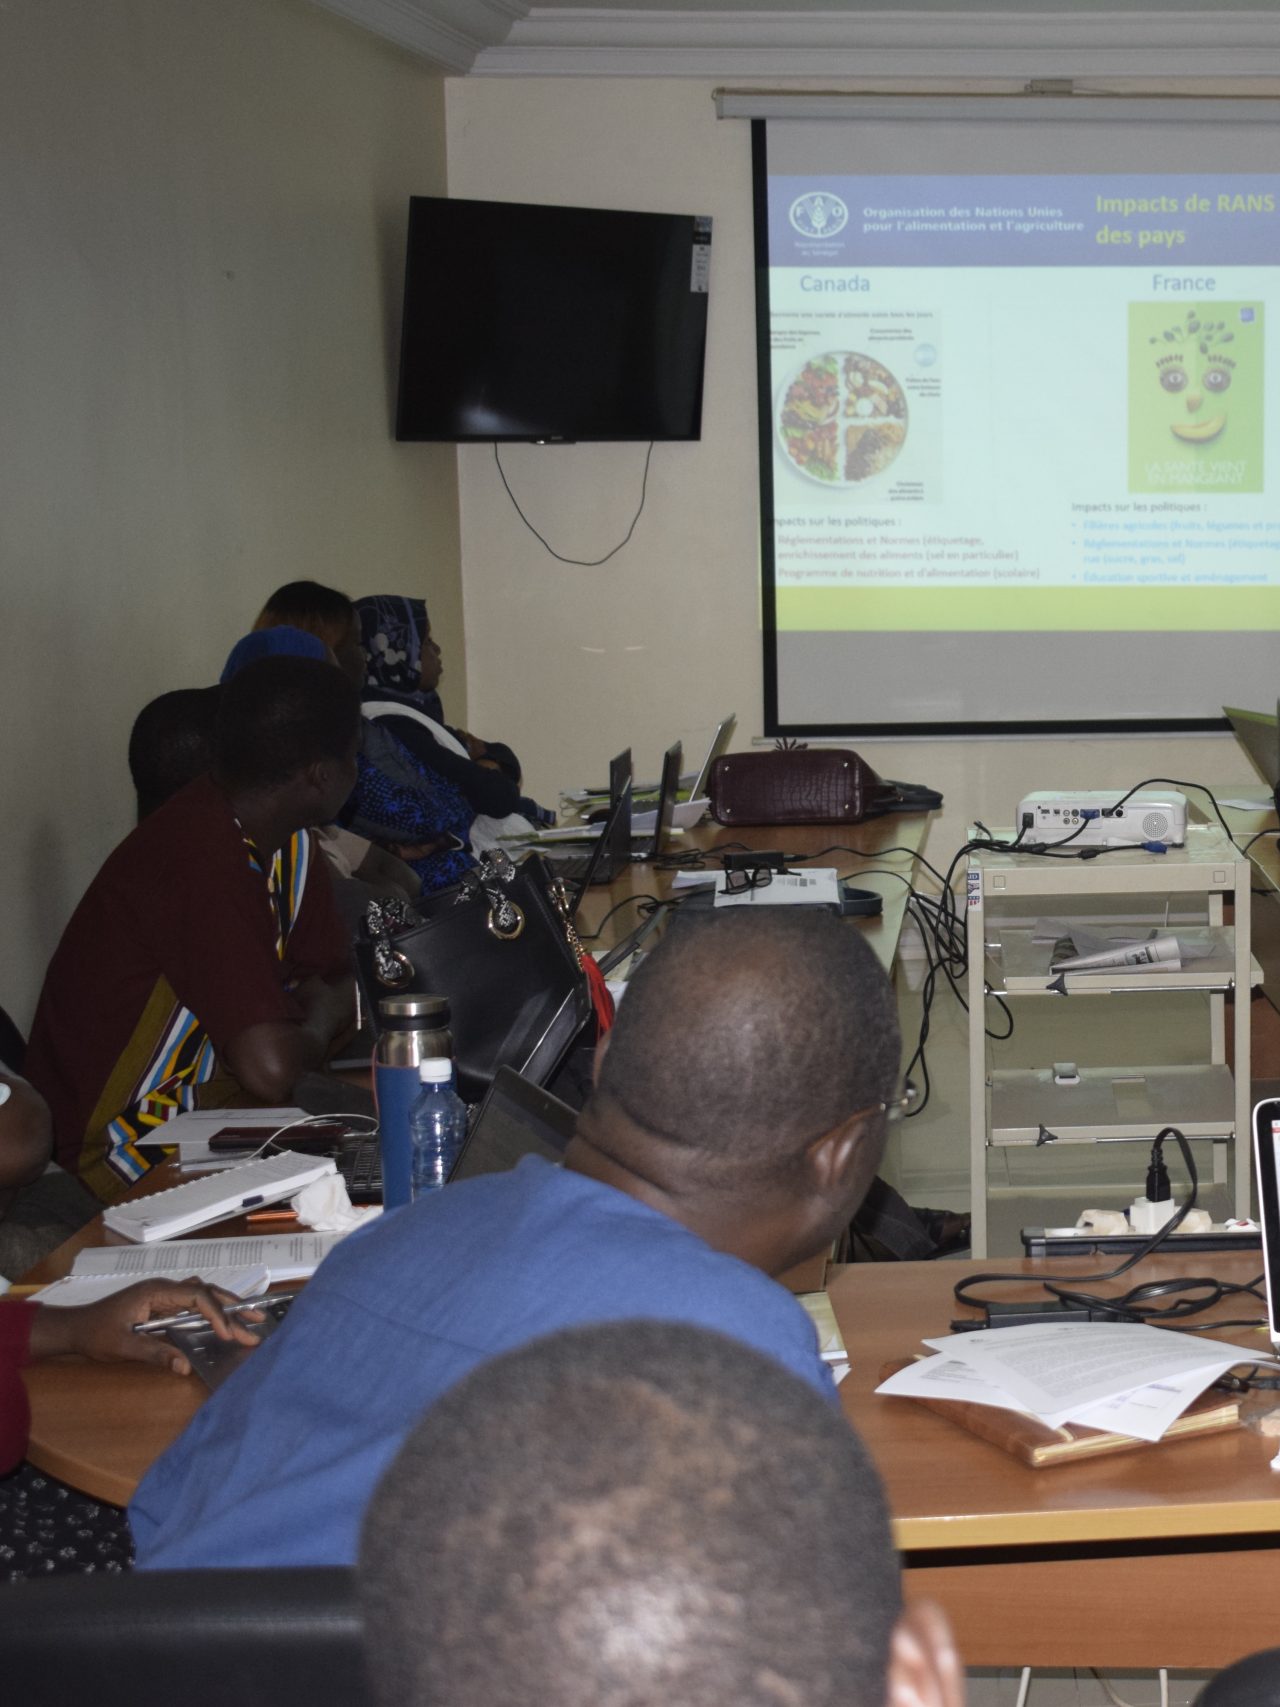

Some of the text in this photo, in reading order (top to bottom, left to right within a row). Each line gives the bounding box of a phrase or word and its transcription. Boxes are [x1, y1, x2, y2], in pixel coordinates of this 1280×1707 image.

[1096, 194, 1178, 217] Impacts
[1185, 193, 1211, 213] de
[1218, 194, 1275, 213] RANS
[863, 206, 1063, 219] Organisation des Nations Unies
[863, 220, 1084, 233] pour l'alimentation et l'agriculture
[1095, 225, 1186, 249] des pays
[800, 273, 871, 292] Canada
[1152, 274, 1217, 291] France
[1072, 502, 1113, 513] Impacts
[1115, 504, 1130, 512] sur
[1133, 502, 1148, 512] les
[1150, 502, 1201, 513] politiques
[809, 519, 824, 527] sur
[827, 517, 842, 526] les
[844, 517, 896, 528] politiques
[866, 535, 878, 545] et
[880, 535, 920, 545] Normes
[1172, 539, 1182, 548] et
[1185, 538, 1226, 548] Normes
[778, 550, 857, 560] enrichissement
[859, 550, 877, 560] des
[880, 550, 924, 560] aliments
[779, 567, 838, 579] Programme
[840, 567, 854, 578] de
[856, 567, 902, 578] nutrition
[904, 568, 915, 578] et
[917, 567, 991, 578] d'alimentation
